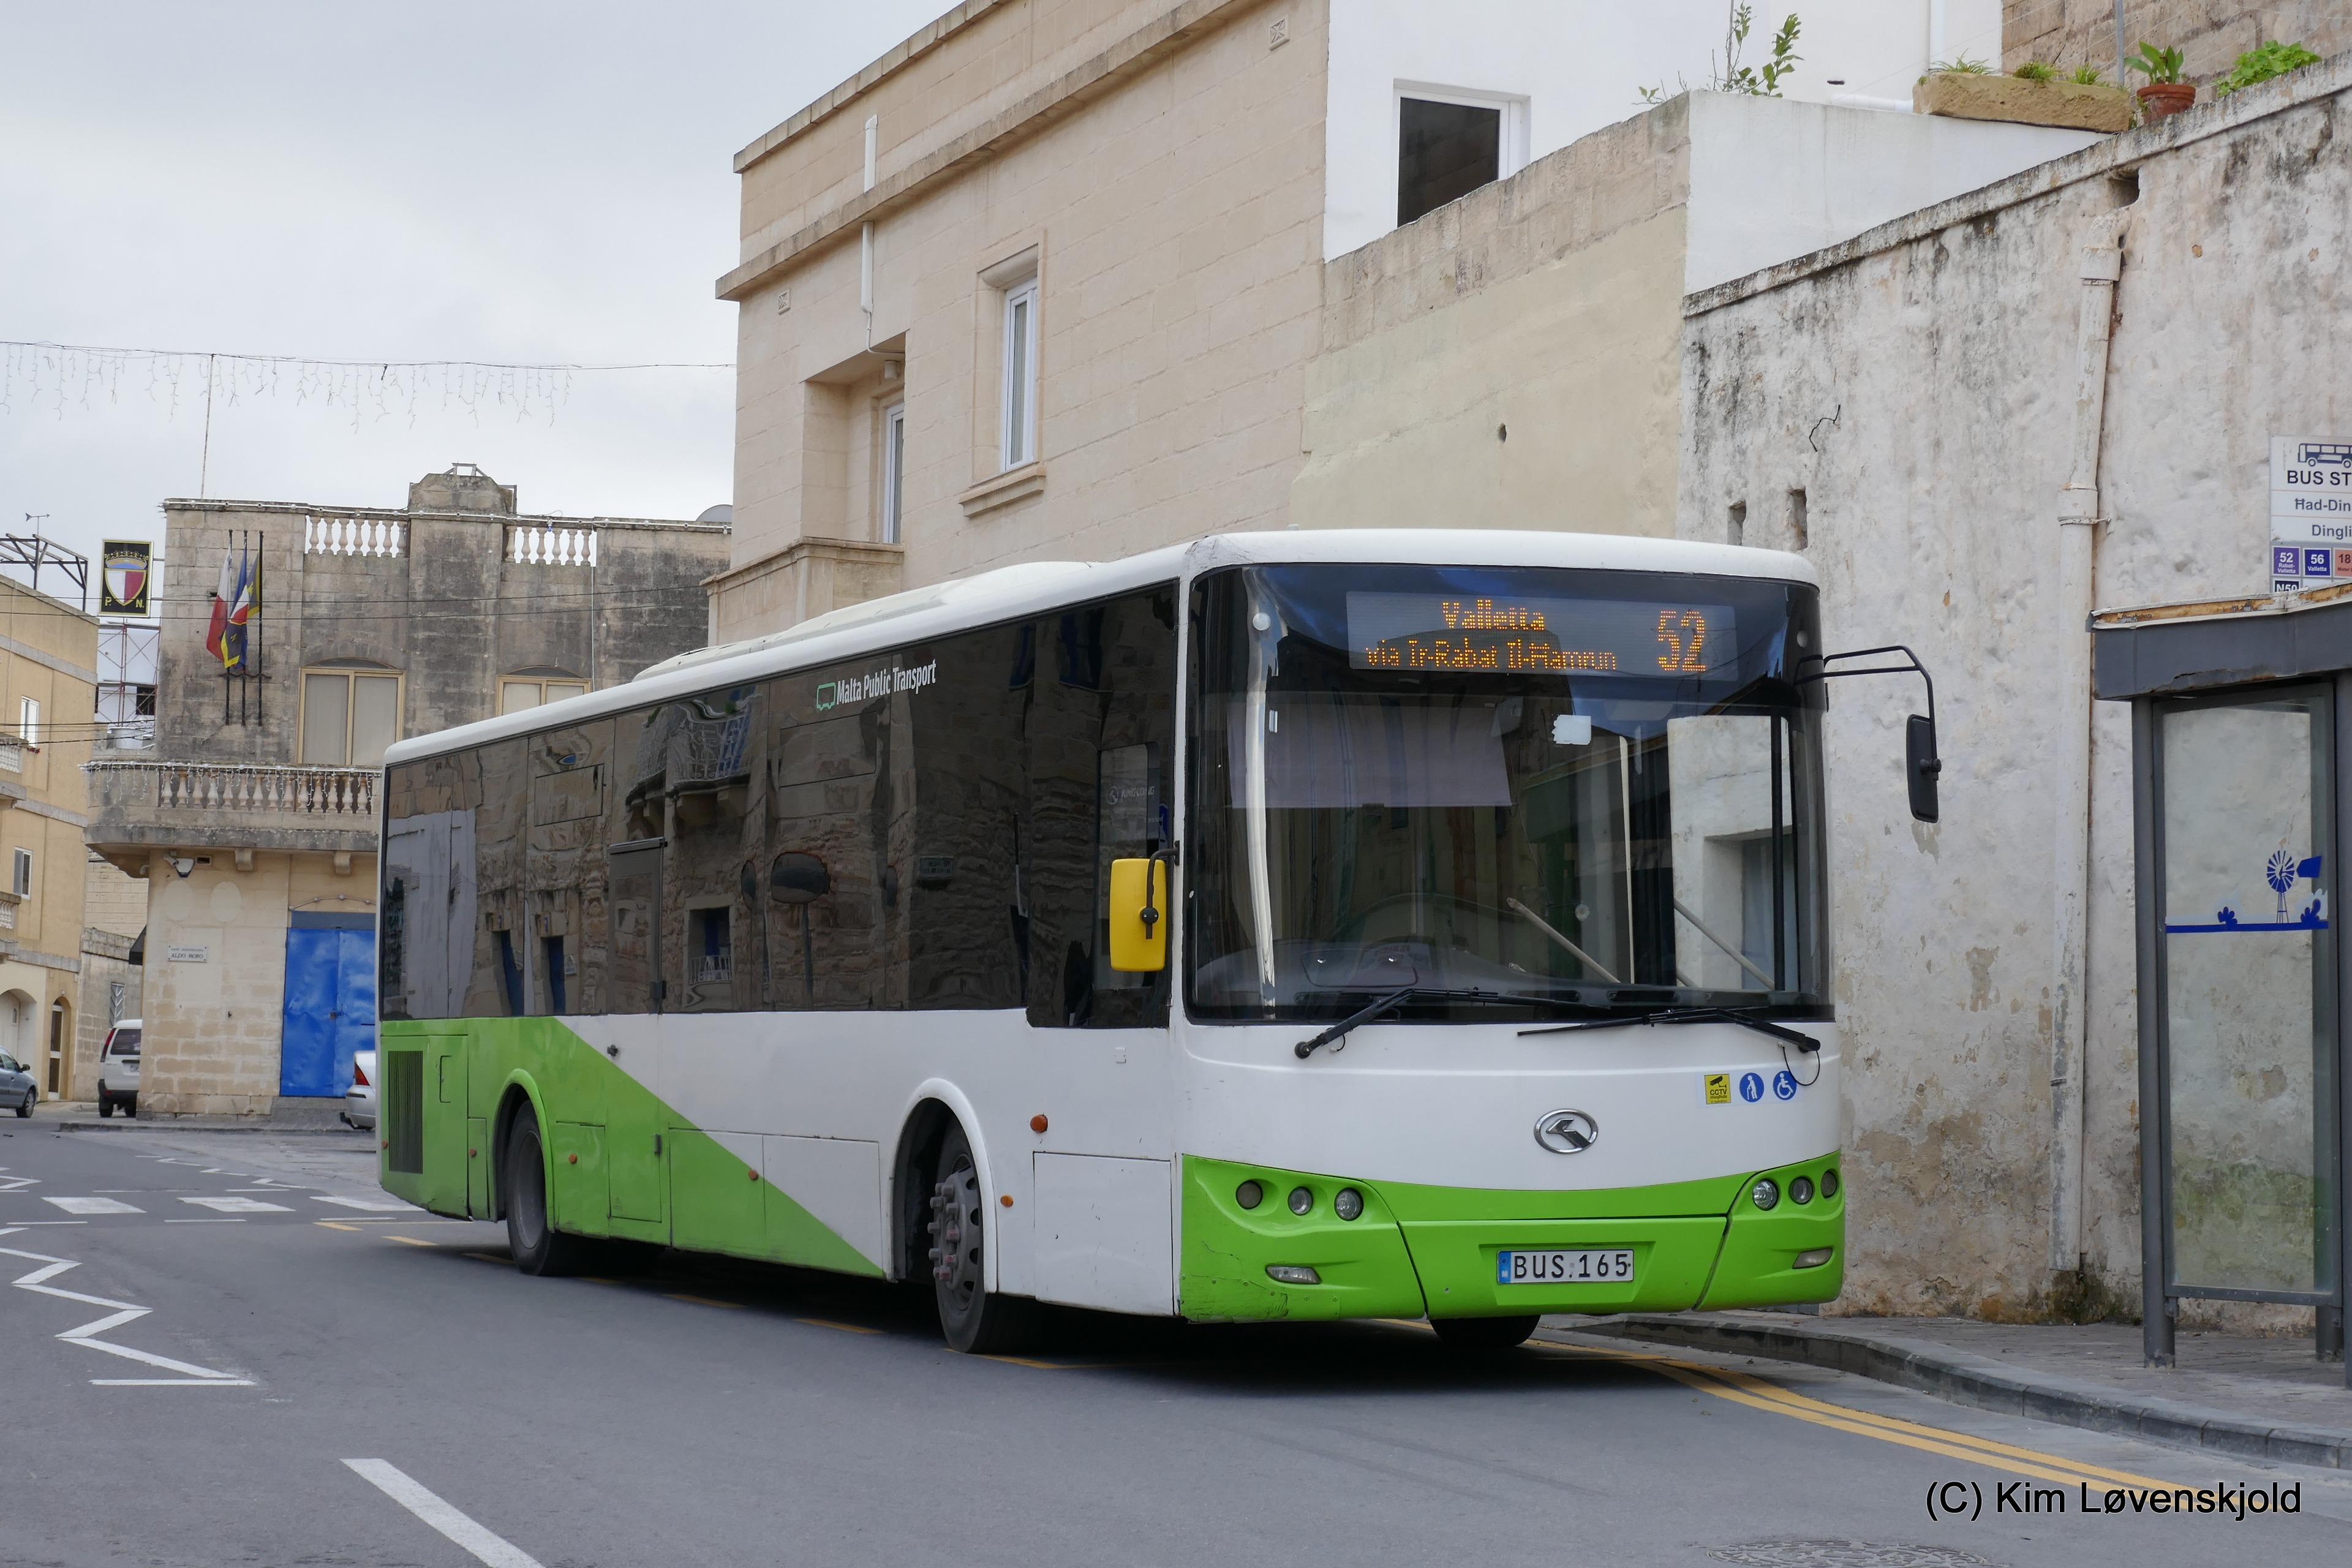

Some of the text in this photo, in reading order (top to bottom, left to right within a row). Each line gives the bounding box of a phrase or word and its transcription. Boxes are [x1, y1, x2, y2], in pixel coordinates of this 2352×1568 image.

[2287, 470, 2323, 485] BUS
[2294, 498, 2352, 511] Ħad-Din
[2312, 525, 2352, 540] Dingli
[2280, 552, 2293, 563] 52
[2311, 554, 2324, 564] 56
[2339, 554, 2352, 564] 18
[1442, 599, 1546, 630] Valletta
[1657, 610, 1707, 671] 52
[1365, 639, 1400, 666] via
[1408, 638, 1498, 668] Ir-Rabat
[837, 658, 937, 705] Malta Public Transport
[1578, 1253, 1628, 1278] 165
